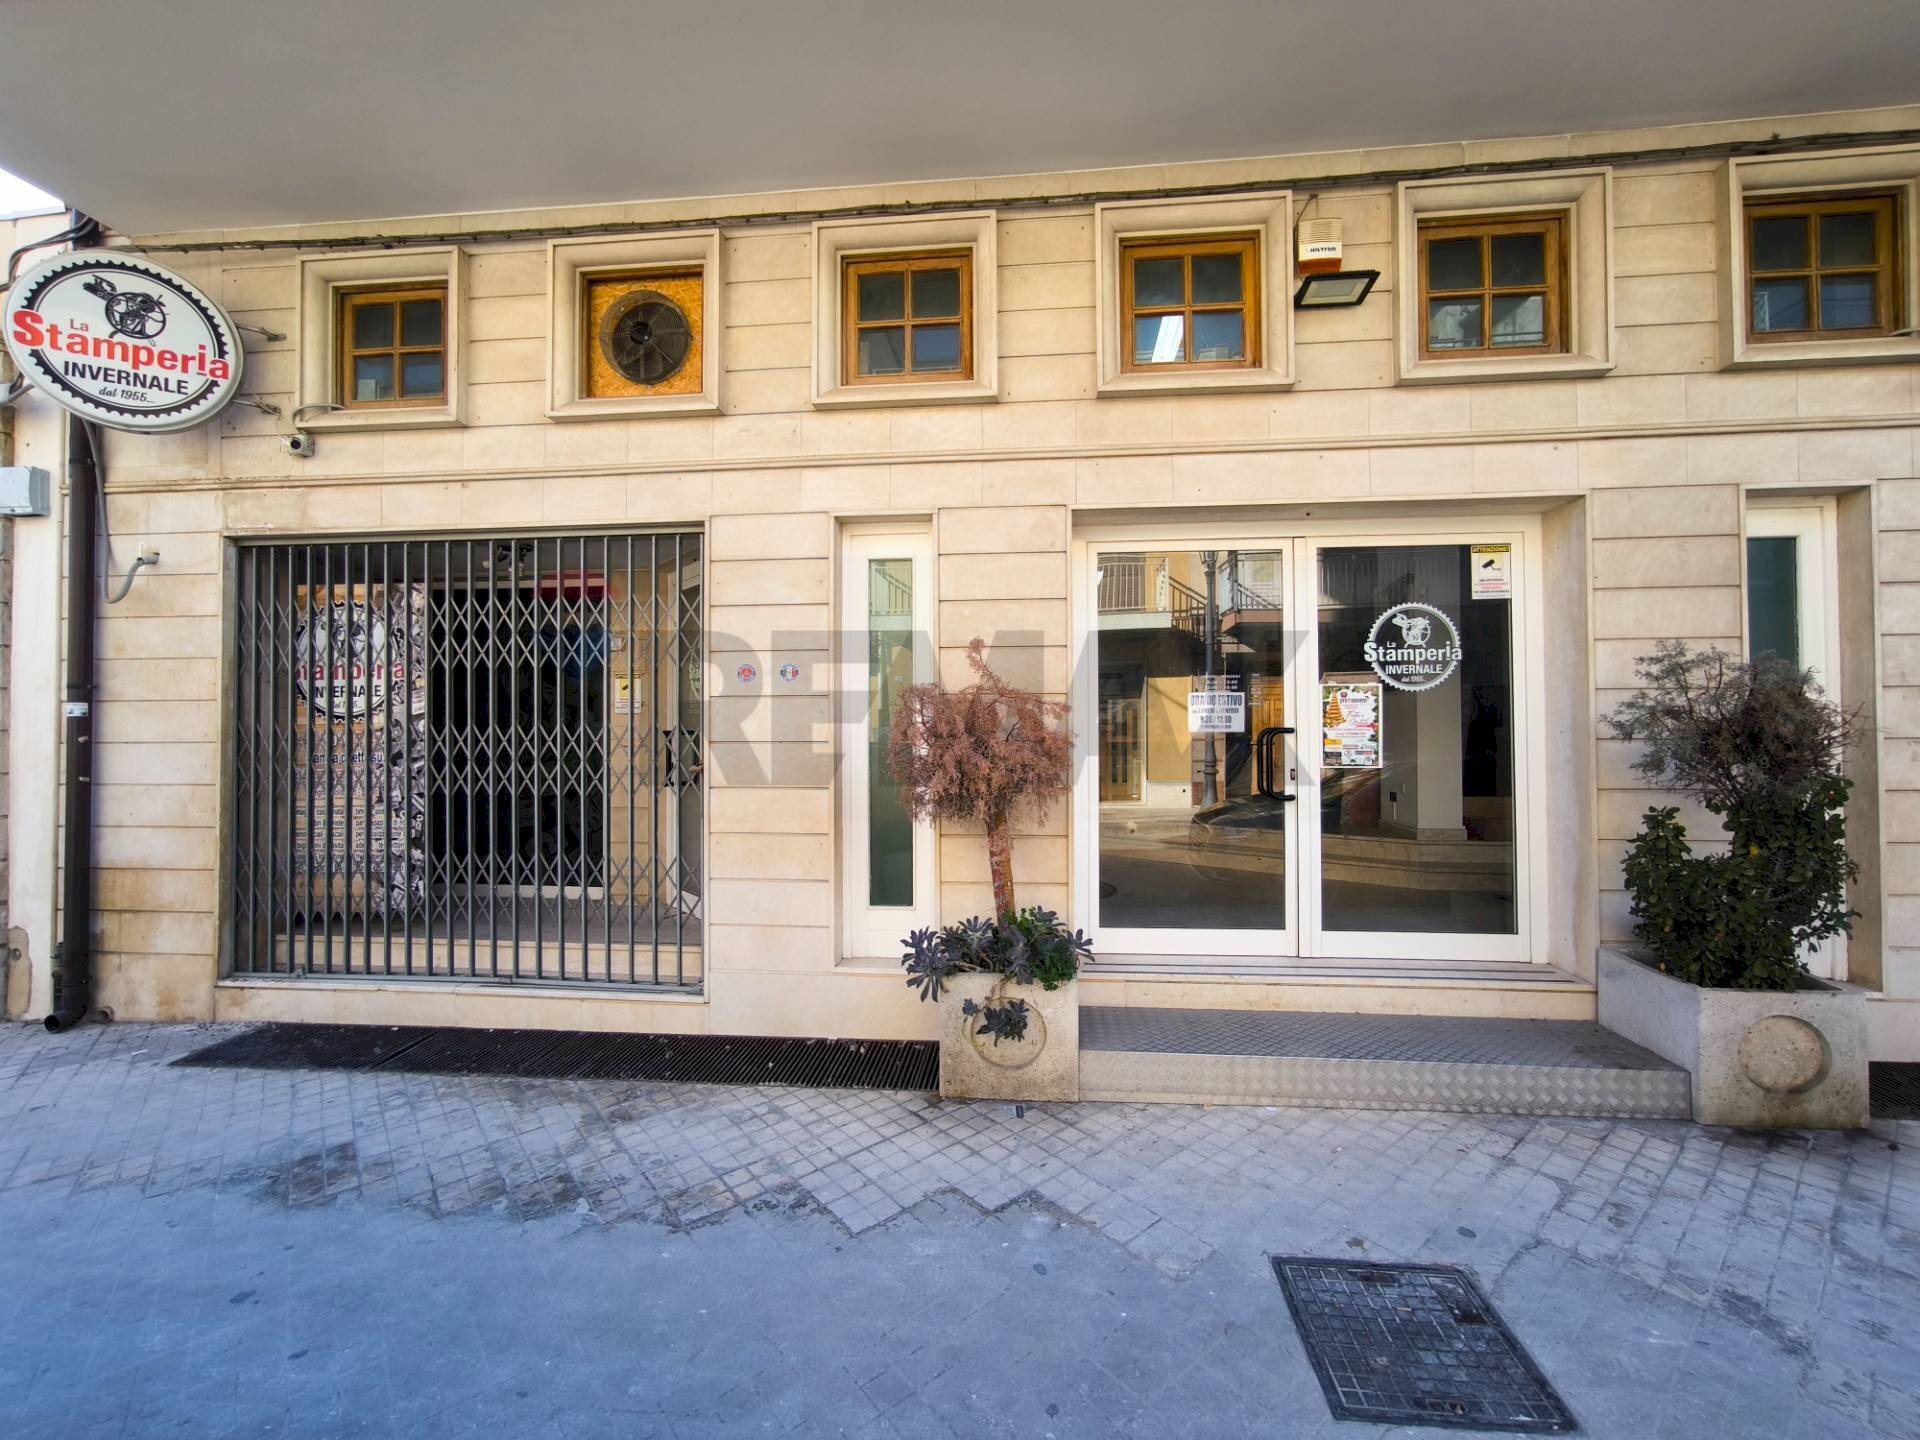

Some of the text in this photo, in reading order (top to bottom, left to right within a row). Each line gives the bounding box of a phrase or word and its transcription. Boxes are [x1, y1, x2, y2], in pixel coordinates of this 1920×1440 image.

[70, 319, 89, 332] La
[13, 310, 230, 380] Stamperia
[63, 360, 189, 395] INVERNALE
[98, 386, 118, 398] dal
[1363, 640, 1462, 664] Stamperia
[1385, 664, 1443, 675] INVERNALE
